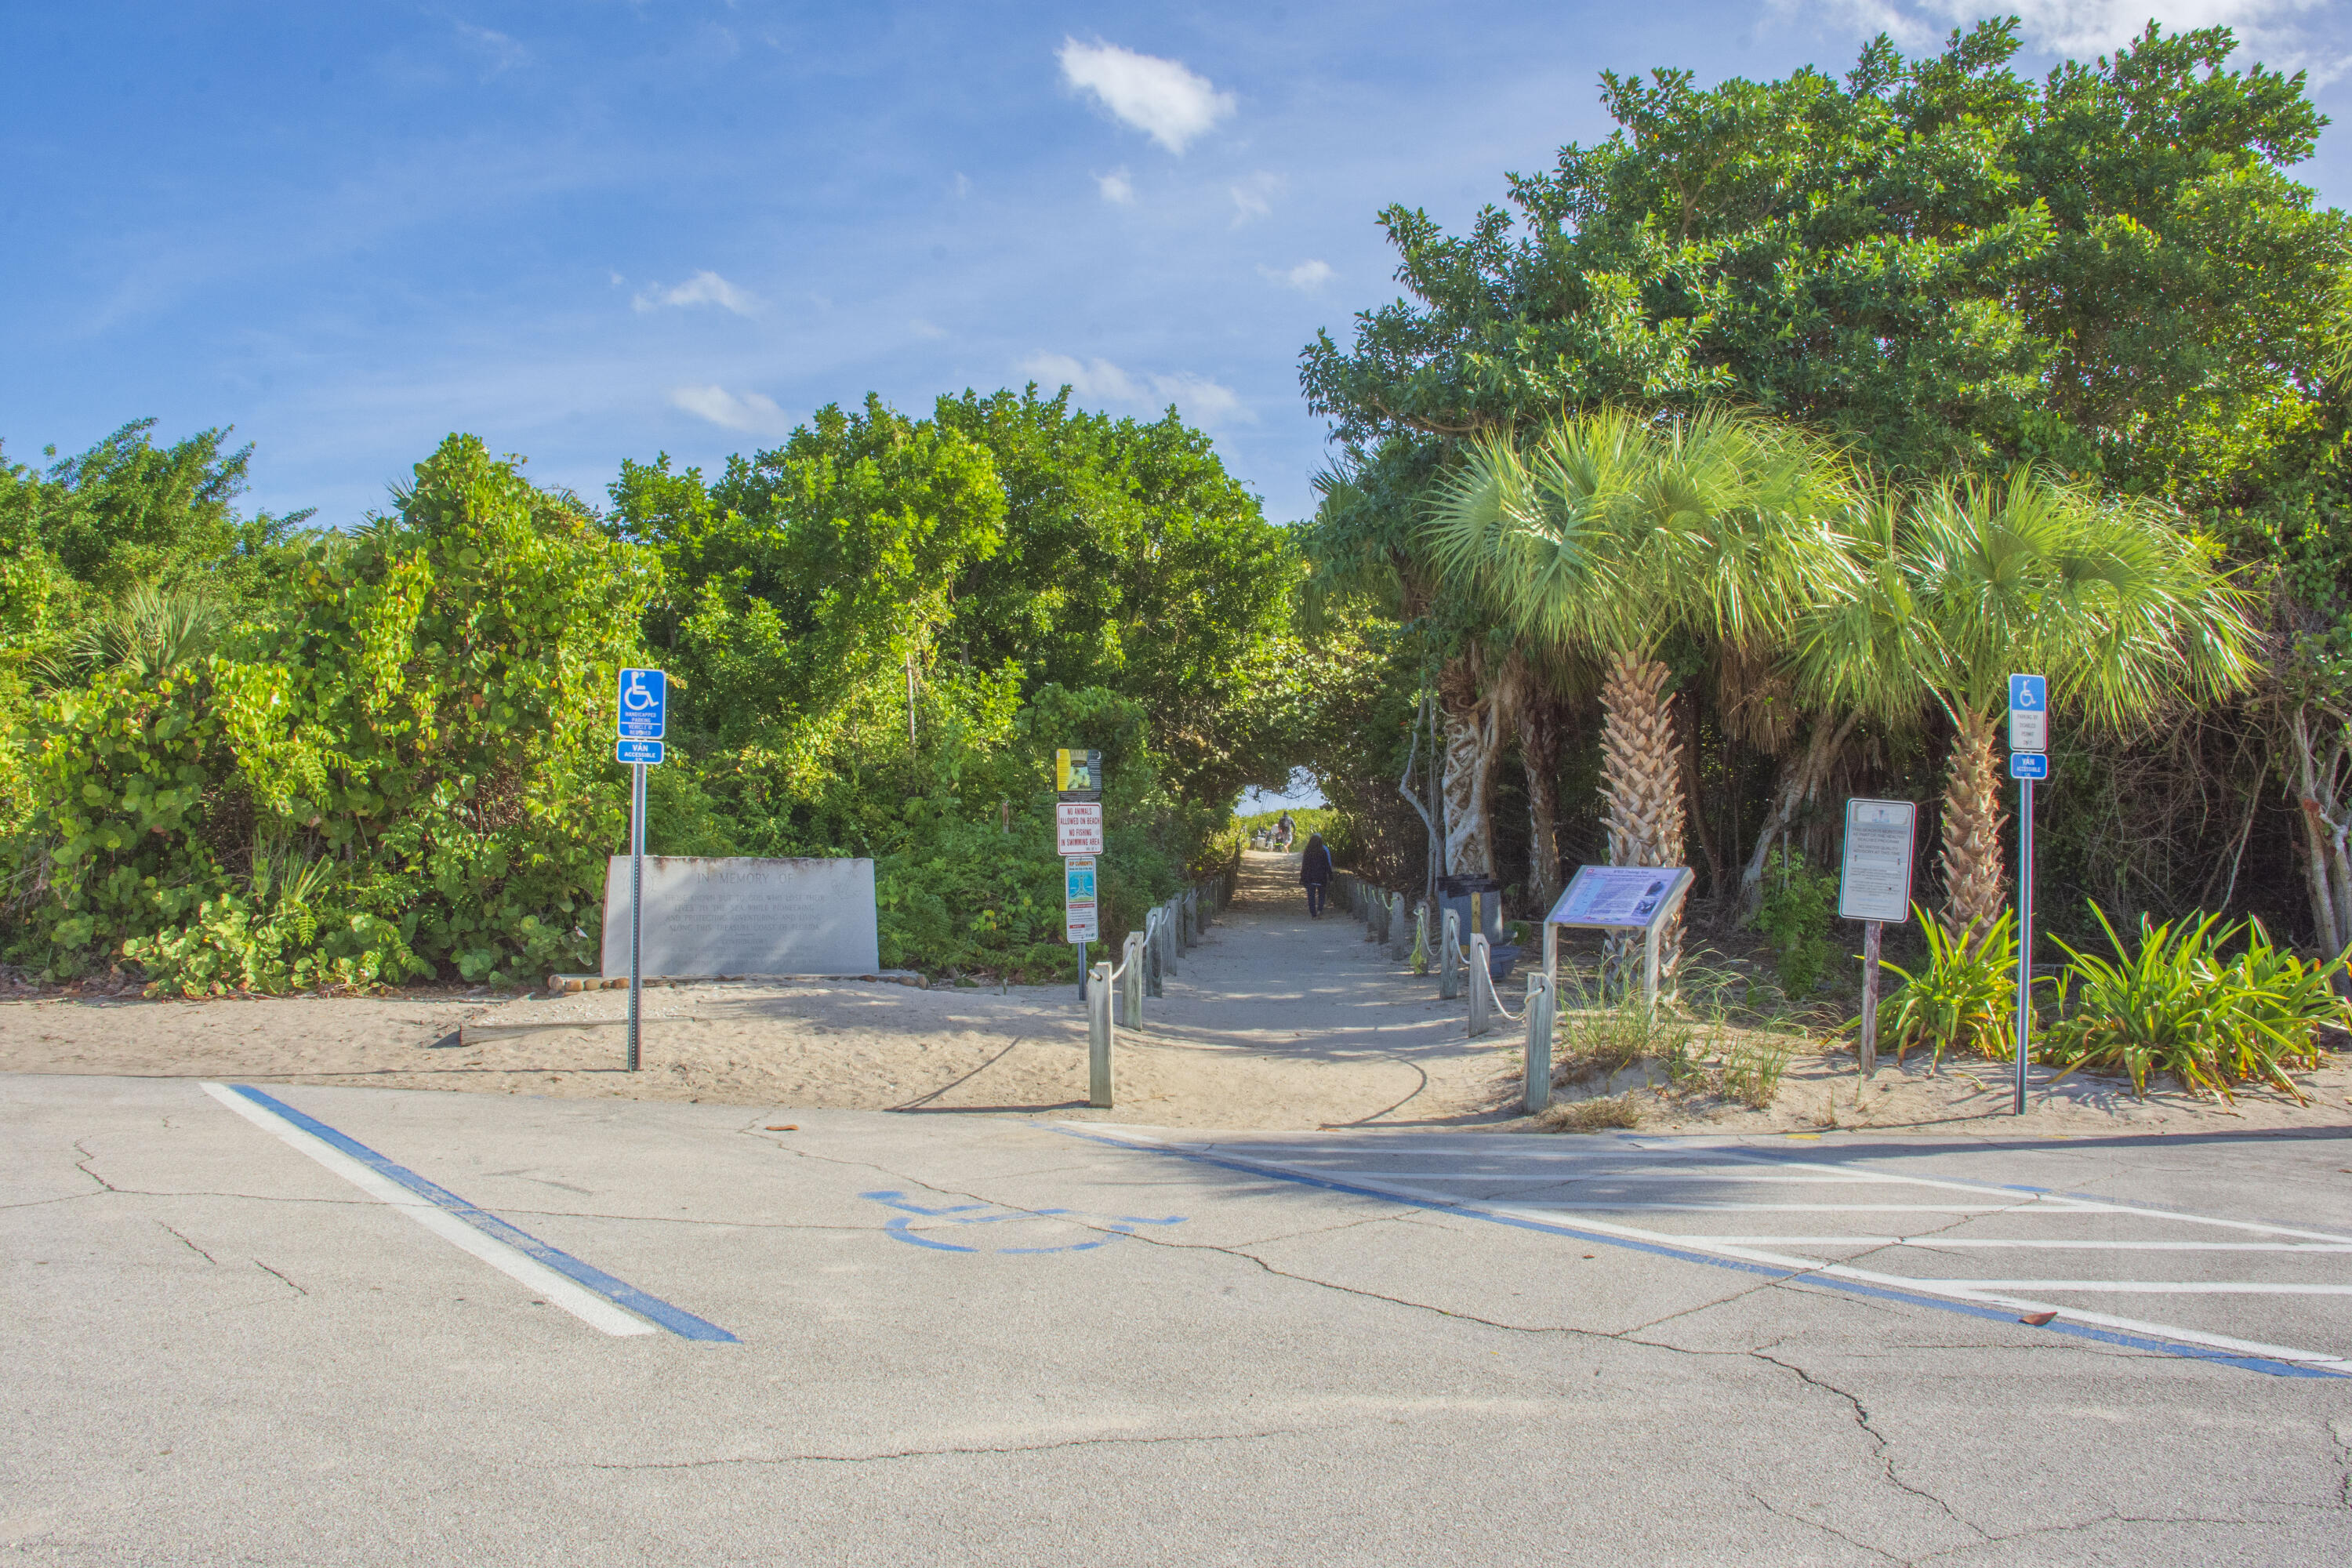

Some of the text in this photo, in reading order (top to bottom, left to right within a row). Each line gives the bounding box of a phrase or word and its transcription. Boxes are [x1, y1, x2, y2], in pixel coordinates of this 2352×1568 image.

[698, 873, 794, 884] IN MEMORY OF
